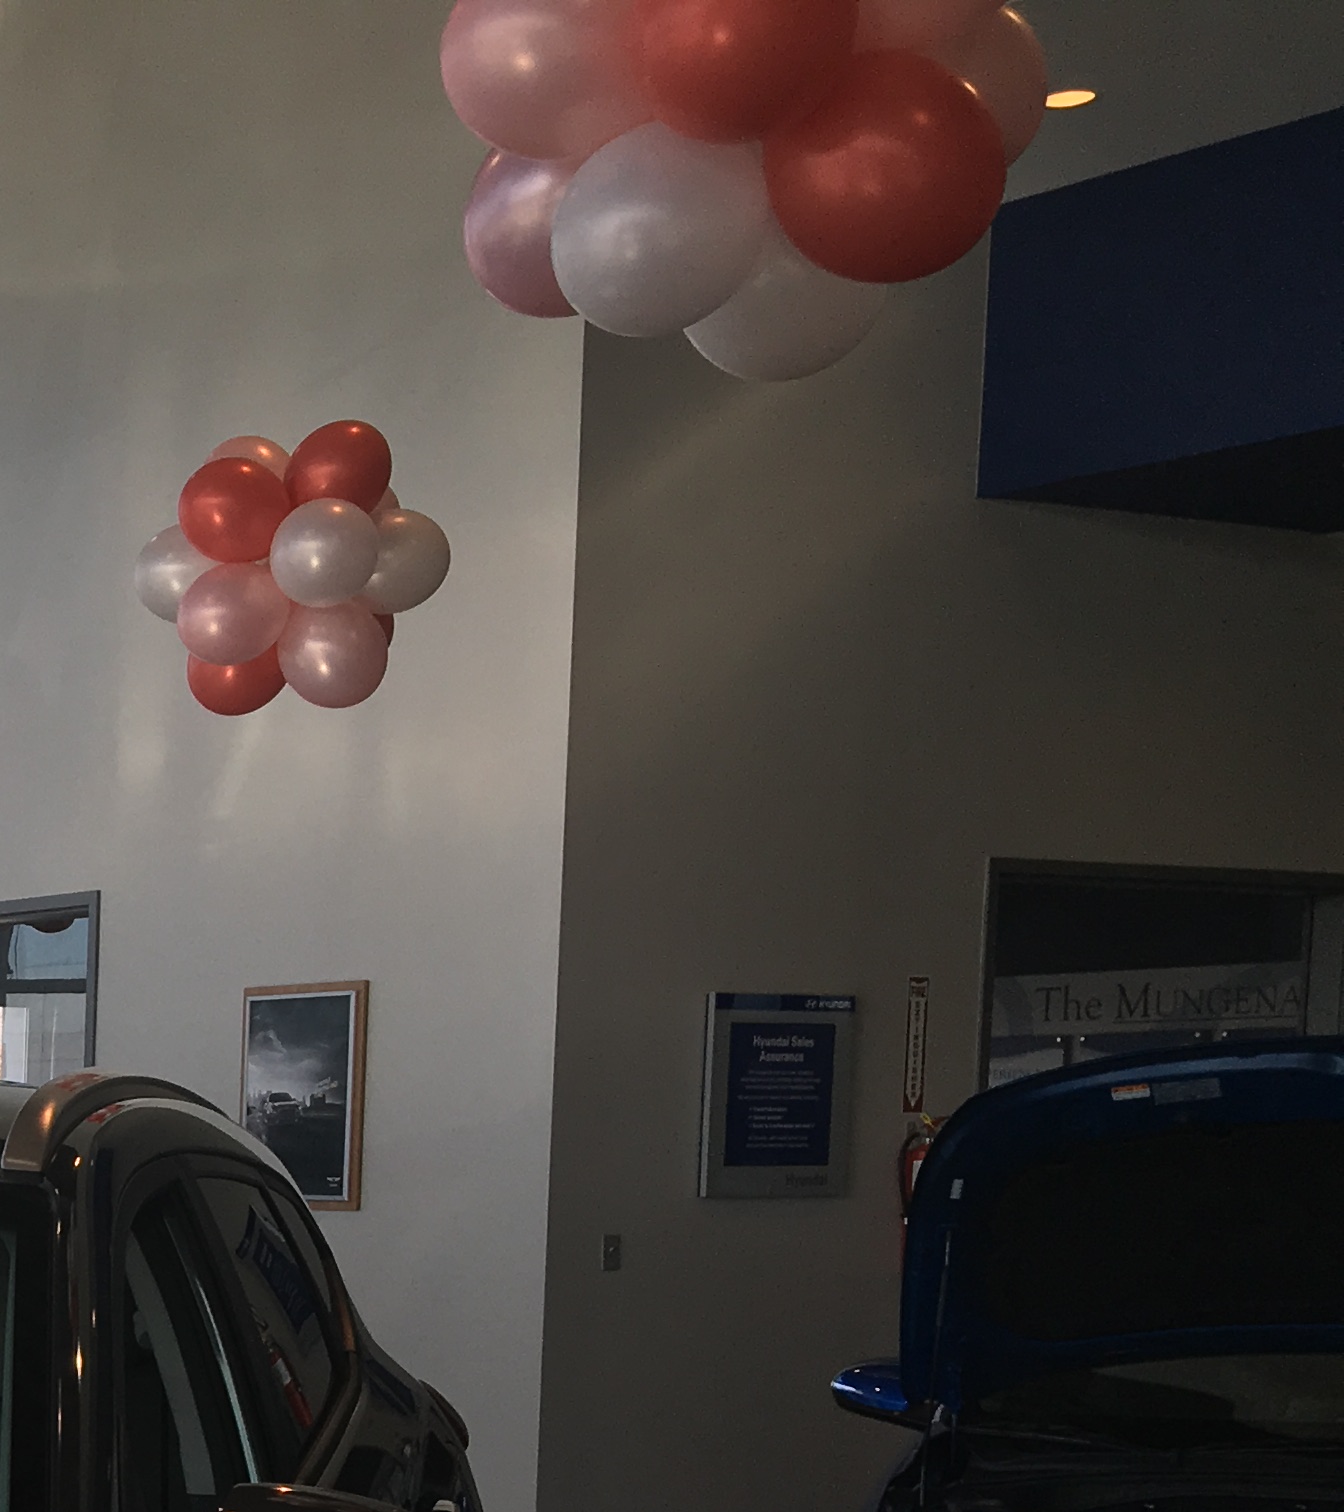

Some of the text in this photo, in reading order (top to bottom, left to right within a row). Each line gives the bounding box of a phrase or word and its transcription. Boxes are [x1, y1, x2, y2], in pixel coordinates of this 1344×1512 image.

[1035, 984, 1103, 1022] The
[753, 1034, 815, 1050] Hyundai Sales
[758, 1051, 805, 1063] Assurance
[785, 1173, 828, 1189] Hyundai
